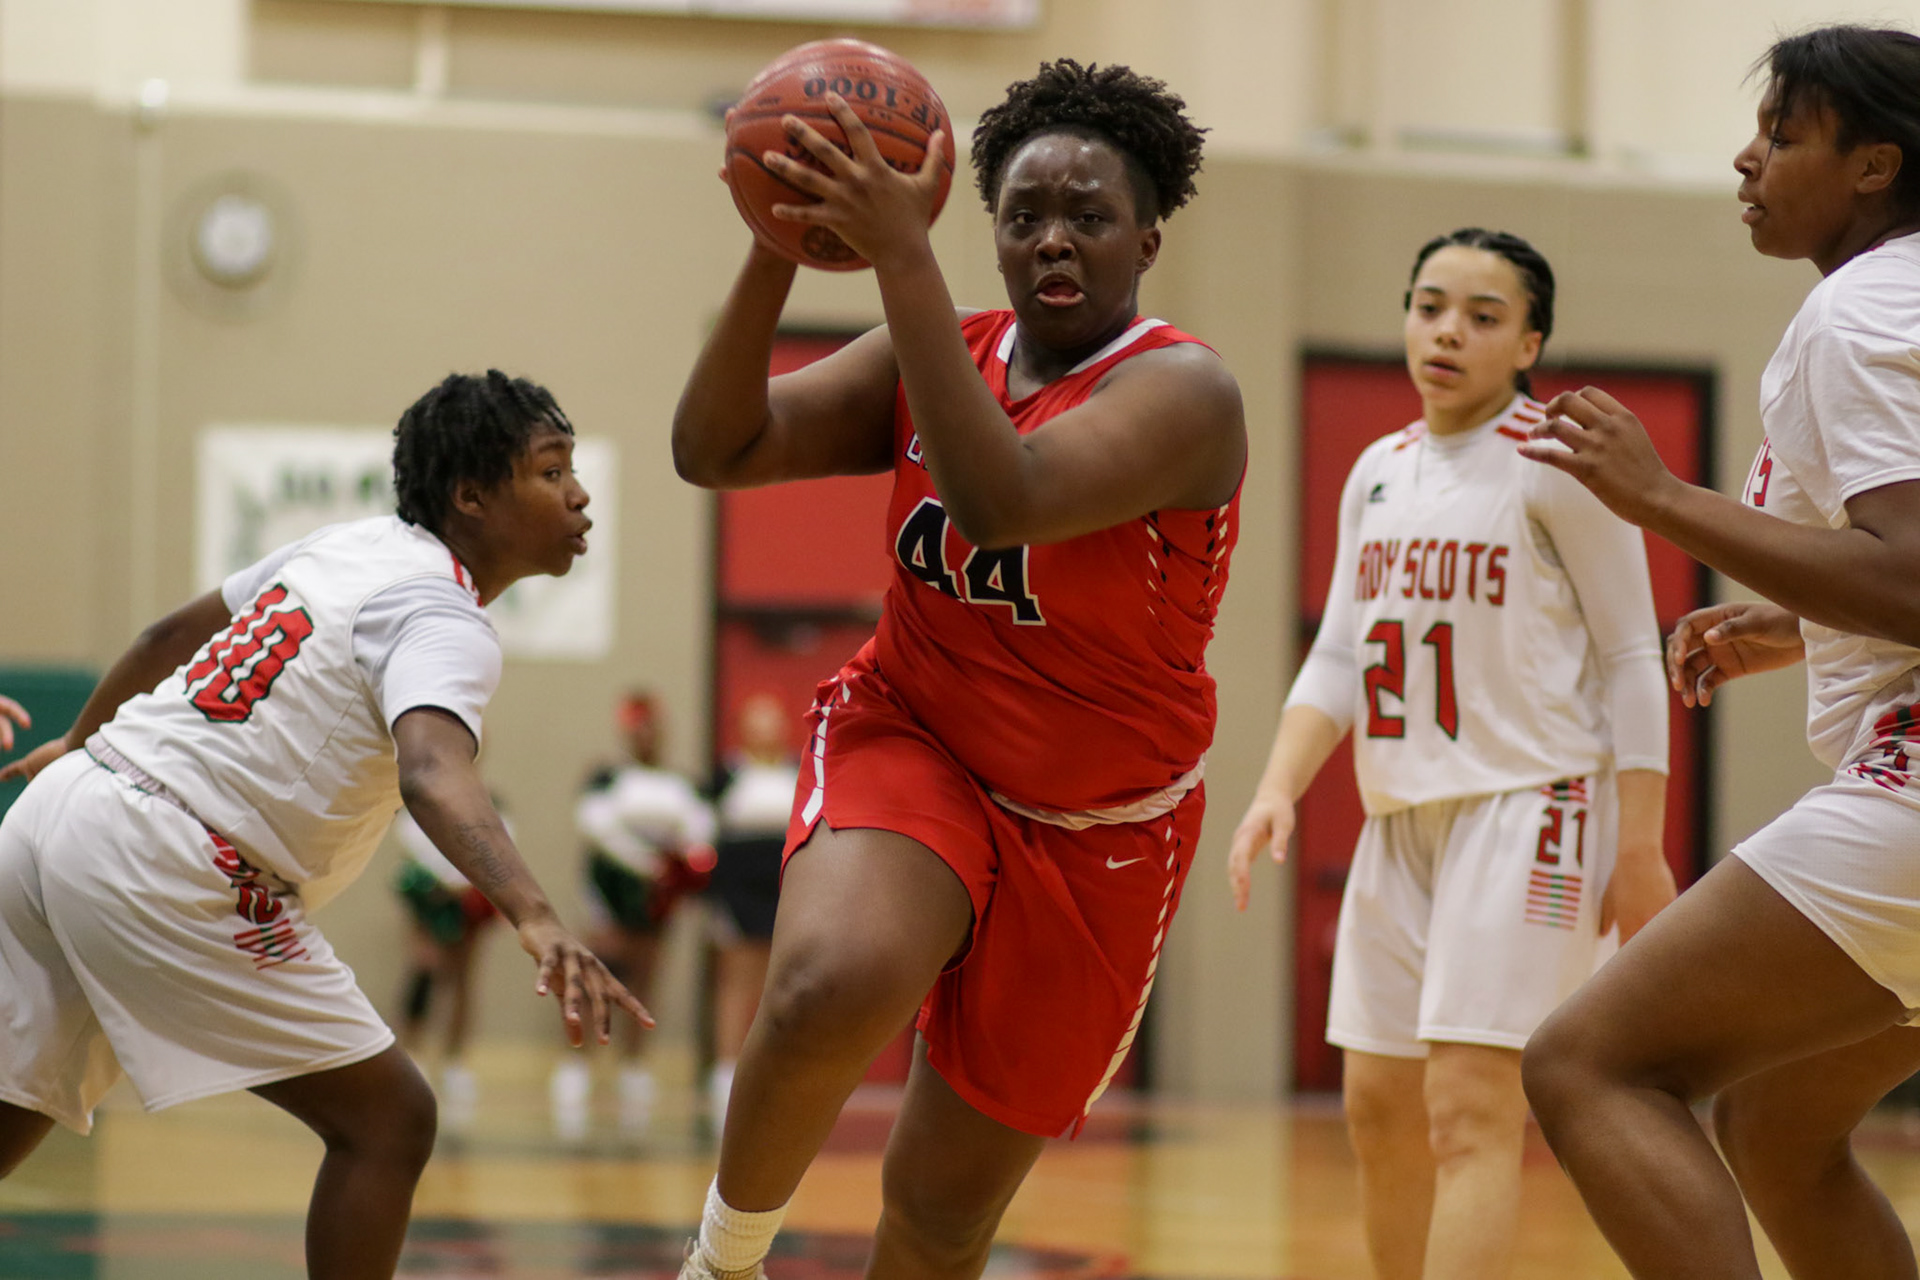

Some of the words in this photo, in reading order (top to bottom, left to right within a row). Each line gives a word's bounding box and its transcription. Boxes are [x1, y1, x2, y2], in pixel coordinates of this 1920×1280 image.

[895, 496, 1047, 626] 44
[184, 582, 314, 724] 10
[1364, 619, 1458, 741] 21
[1536, 806, 1588, 869] 21
